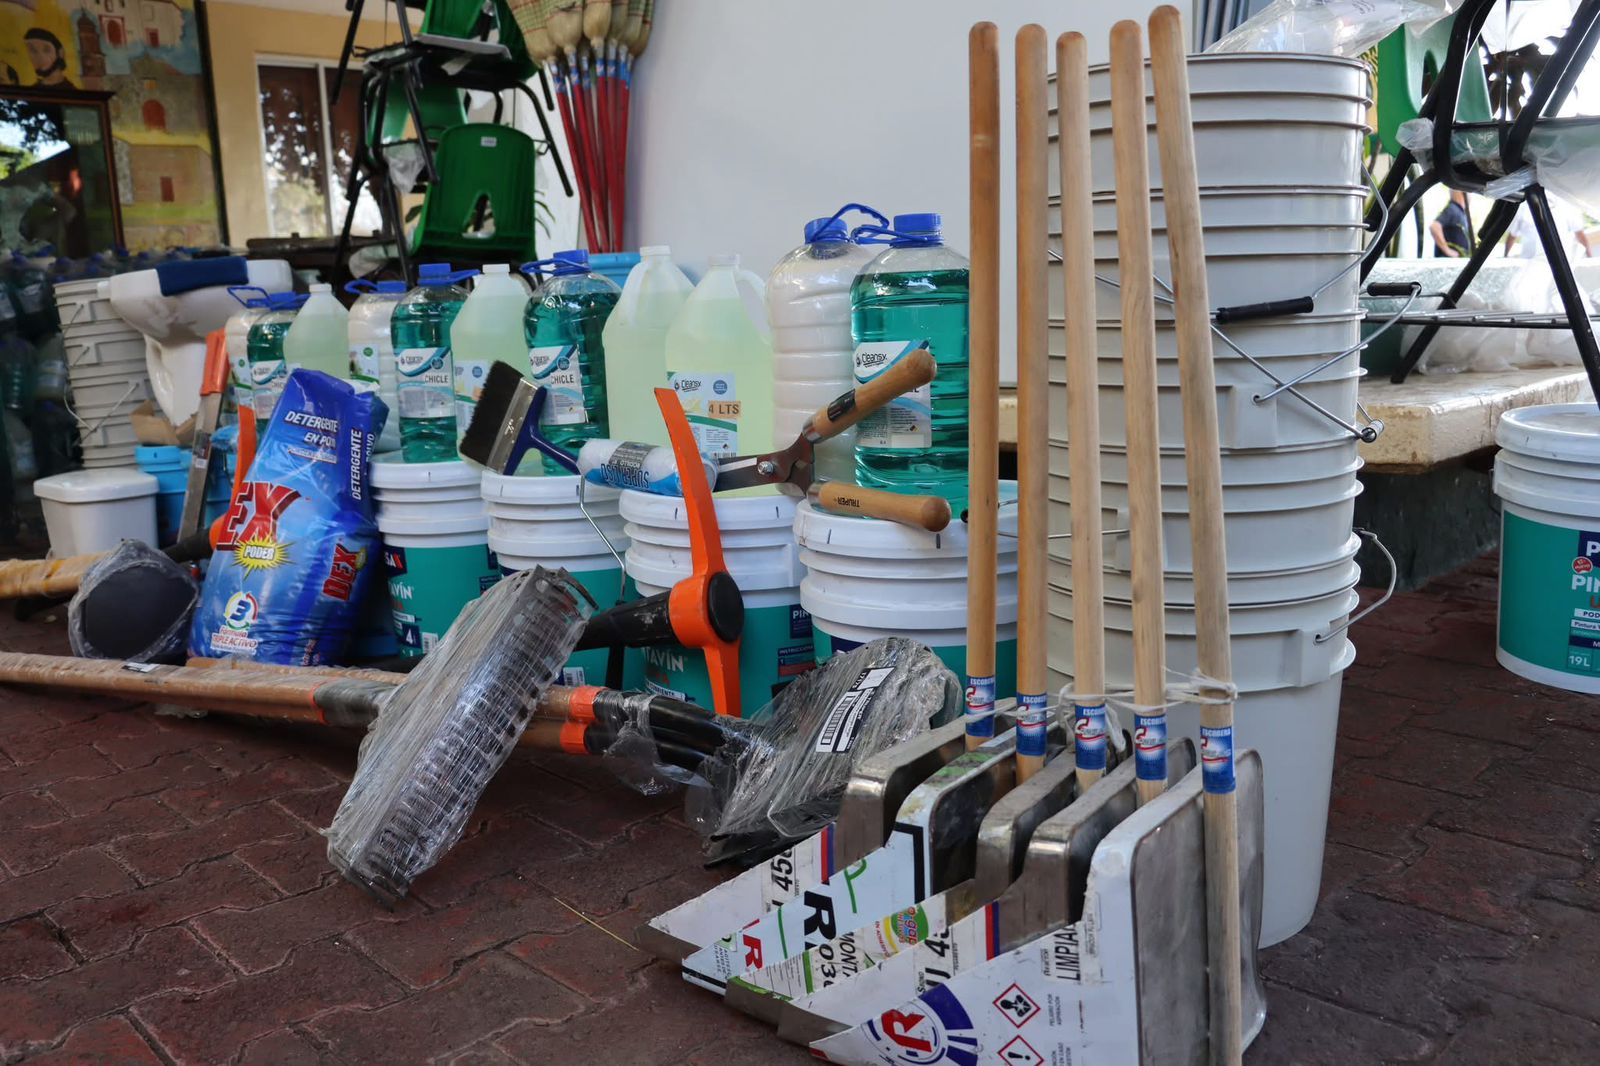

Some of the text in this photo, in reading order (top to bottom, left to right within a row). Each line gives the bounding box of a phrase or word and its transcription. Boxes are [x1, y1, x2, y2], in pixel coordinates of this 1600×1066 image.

[425, 374, 449, 383] CHICLE
[551, 375, 575, 385] CHICLE
[708, 403, 740, 415] 4 LTS
[304, 432, 320, 443] EN
[350, 428, 362, 500] DETERGENTE
[837, 496, 861, 508] TRUPER
[244, 545, 276, 560] PODER
[322, 543, 357, 601] DEX
[229, 599, 252, 621] 3
